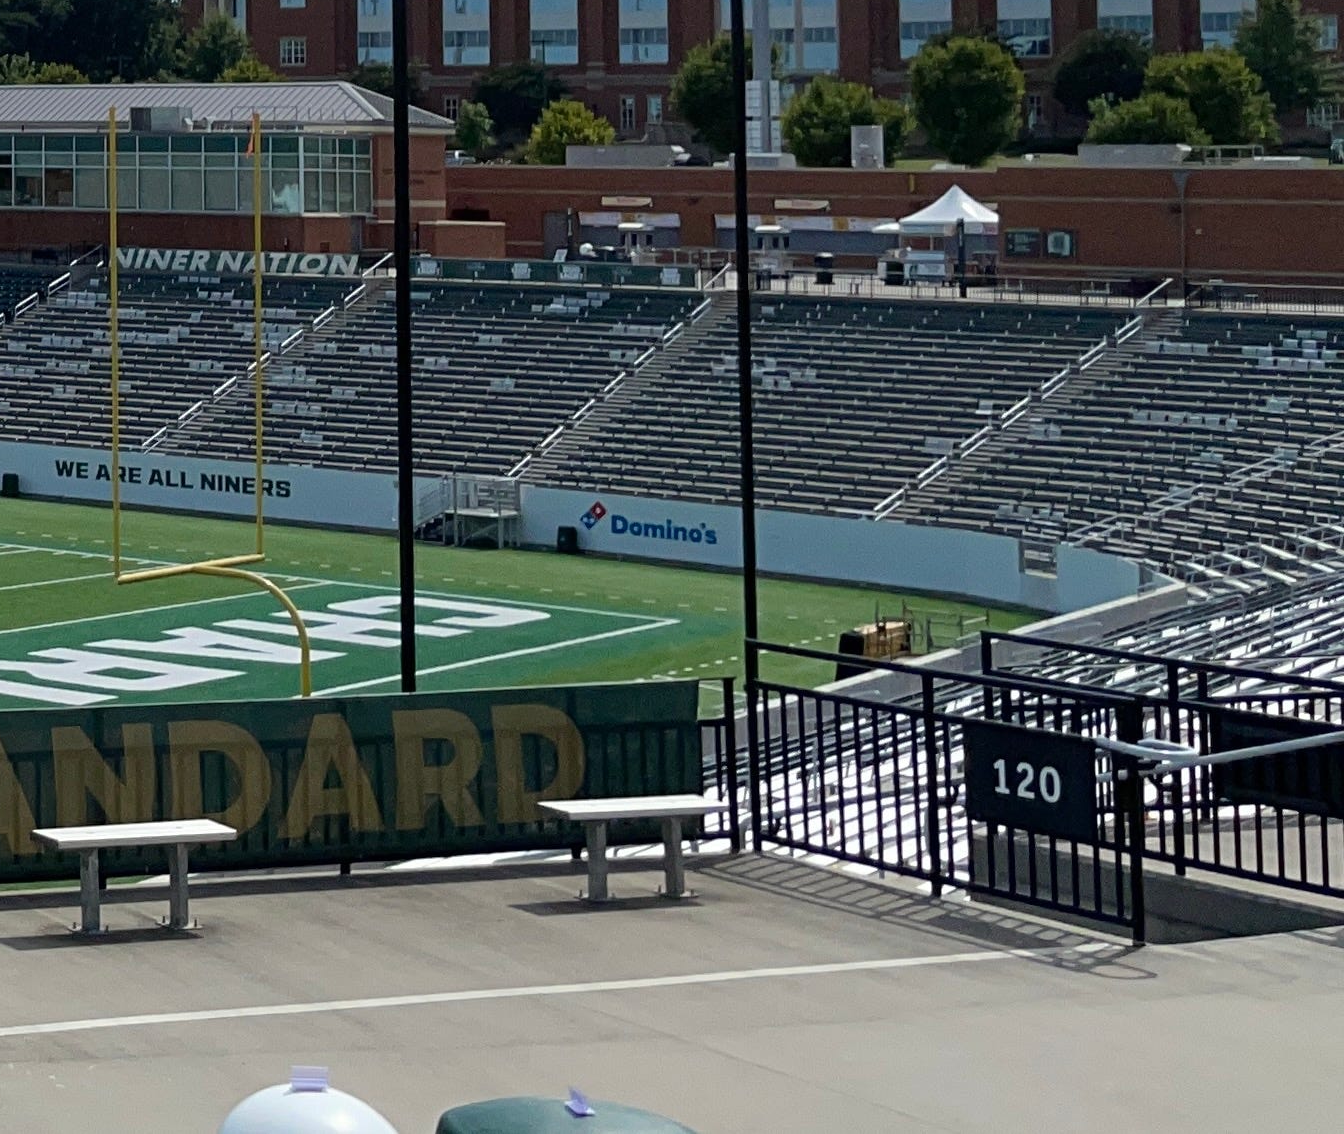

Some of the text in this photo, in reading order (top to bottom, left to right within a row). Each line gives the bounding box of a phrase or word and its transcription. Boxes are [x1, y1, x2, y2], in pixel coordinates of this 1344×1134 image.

[110, 247, 360, 276] NINER NATION
[55, 460, 292, 498] WE ARE ALL NINERS
[611, 514, 718, 545] Domino's
[993, 758, 1061, 803] 120
